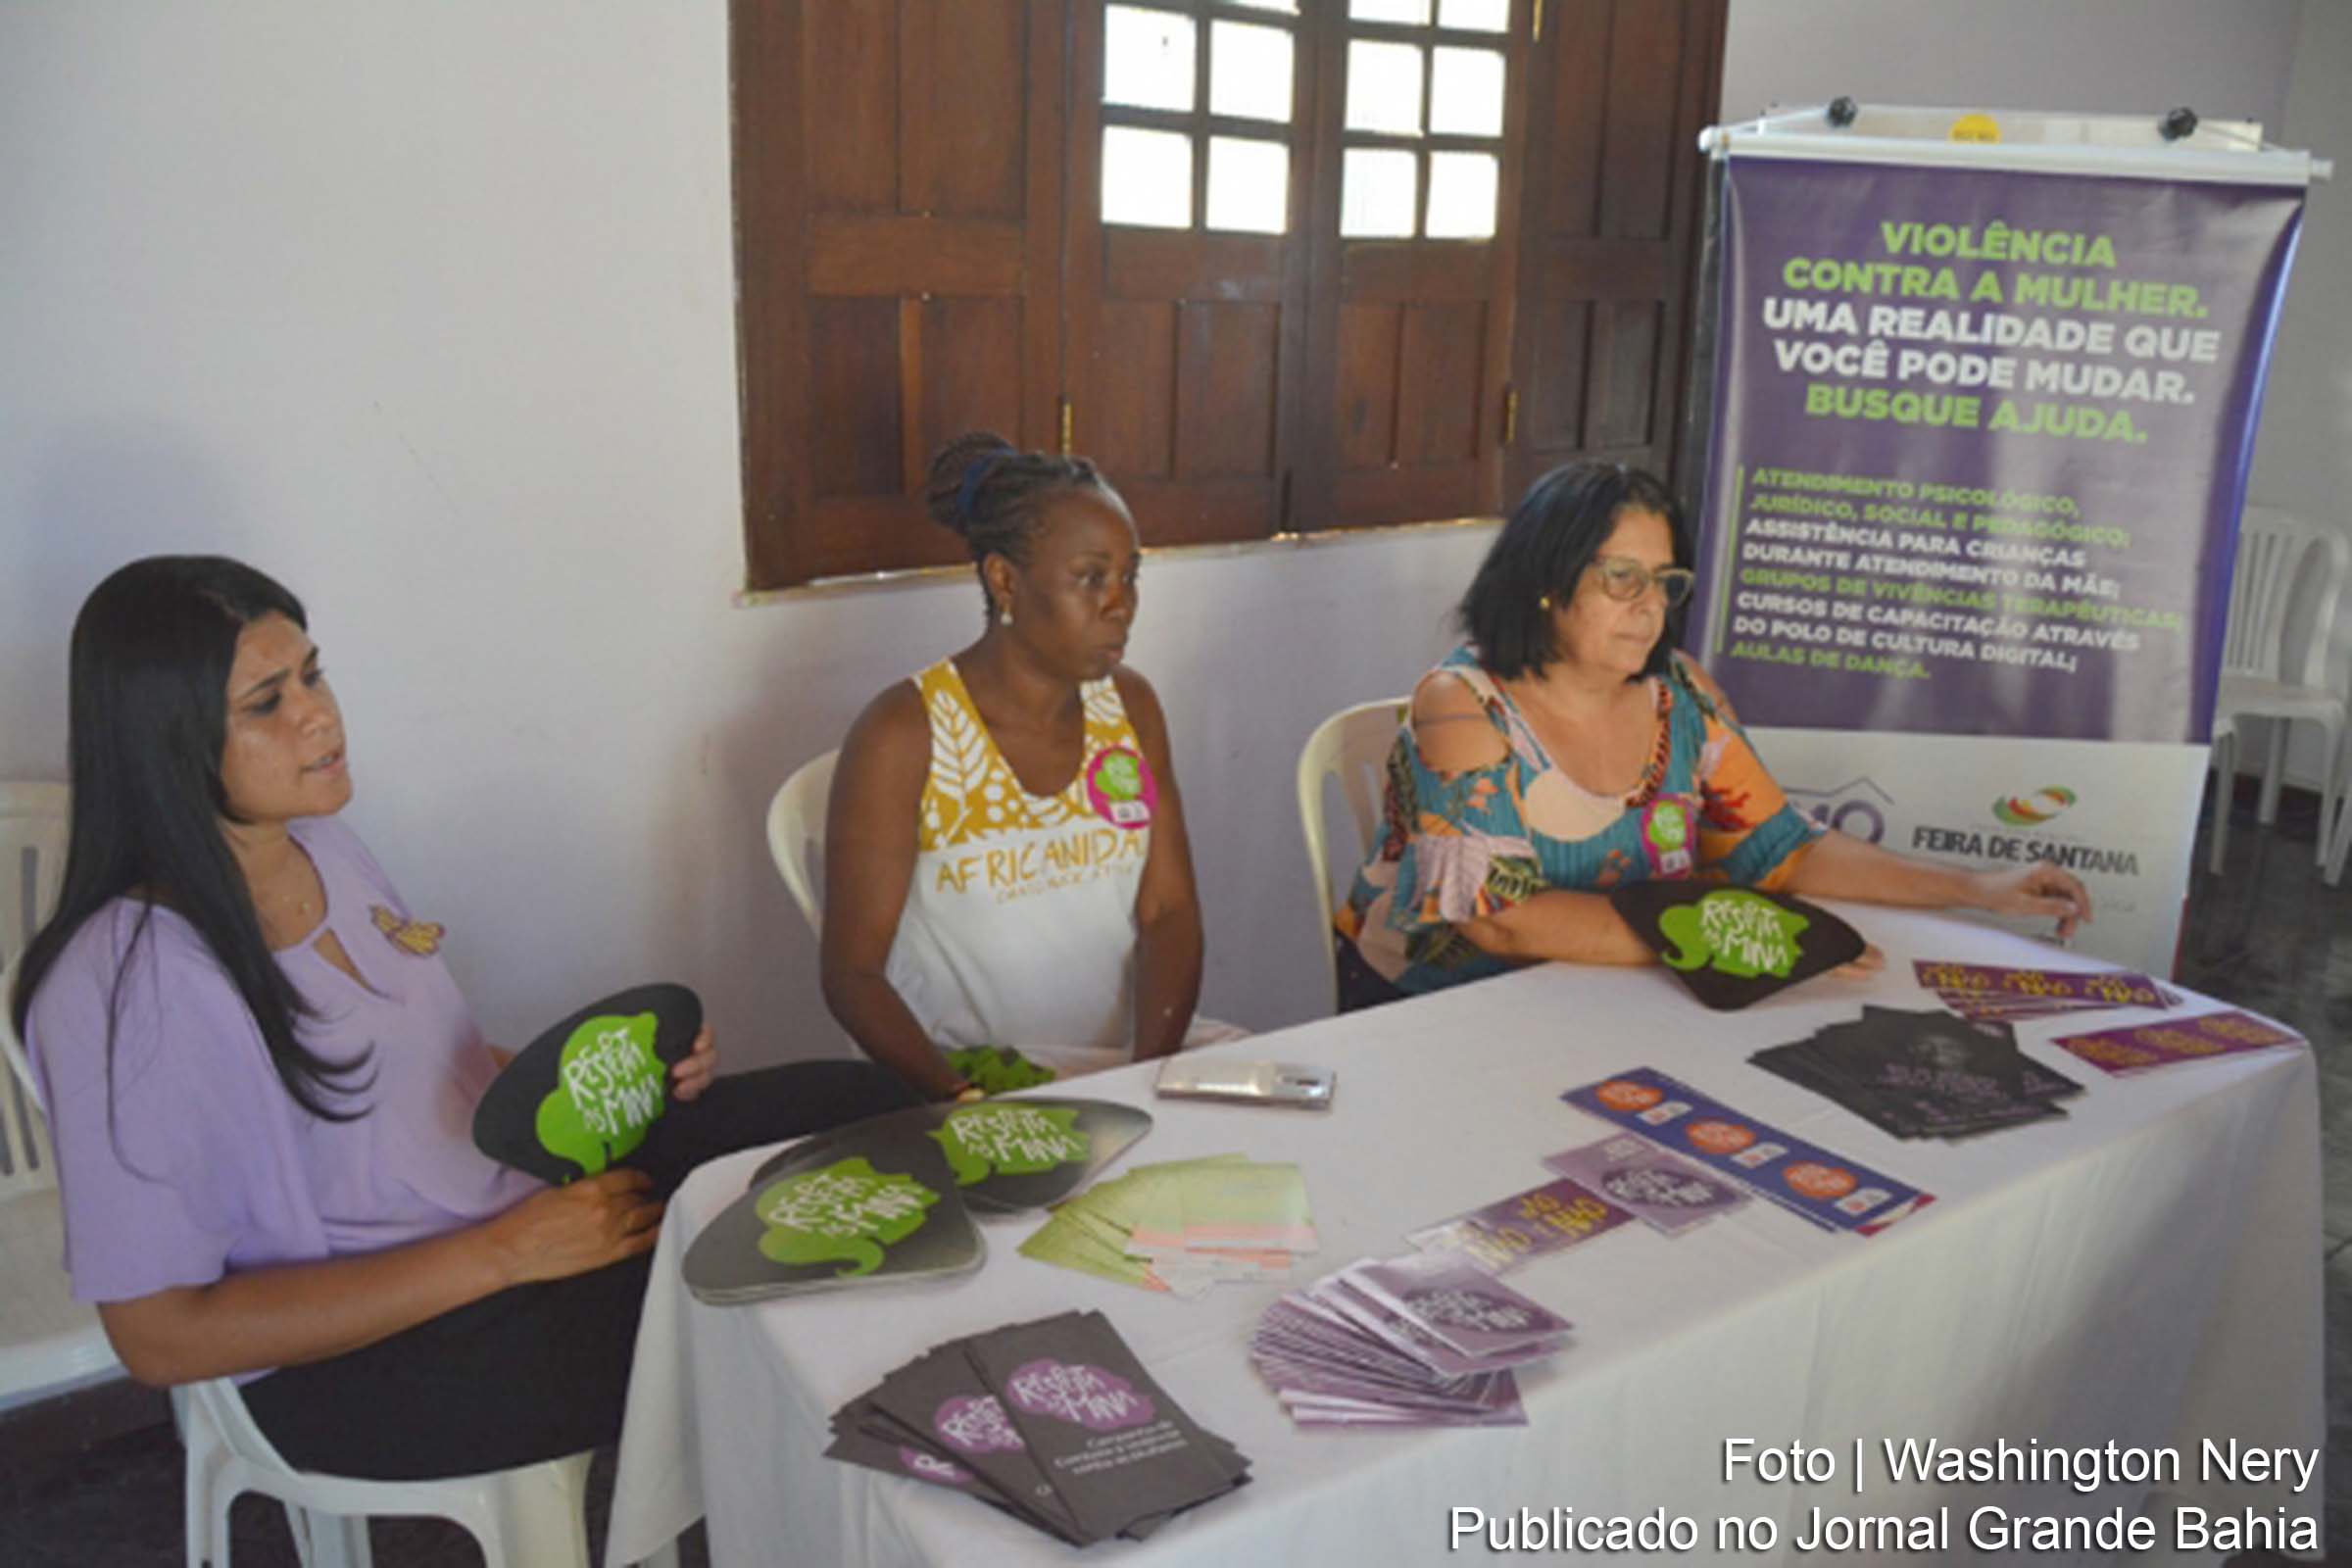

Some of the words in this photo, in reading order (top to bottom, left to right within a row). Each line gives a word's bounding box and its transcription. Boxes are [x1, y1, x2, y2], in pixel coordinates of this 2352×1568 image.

[1881, 220, 2117, 269] VIOLÊNCIA
[1783, 258, 1959, 300] CONTRA
[1970, 270, 2003, 302] A
[2013, 271, 2209, 318] MULHER.
[1763, 297, 1858, 334] UMA
[1868, 305, 2115, 353] REALIDADE
[2124, 325, 2222, 363] QUE
[1774, 339, 1890, 378] VOCÊ
[1897, 349, 2018, 389] PODE
[2025, 359, 2195, 404] MUDAR.
[1805, 383, 1982, 428] BUSQUE
[1987, 398, 2149, 443] AJUDA.
[1752, 467, 1914, 498] ATENDIMENTO
[1864, 504, 1946, 528] SOCIAL
[1952, 513, 1967, 530] E
[1741, 543, 1852, 569] DURANTE
[1854, 554, 2018, 587] ATENDIMENTO
[2022, 570, 2056, 592] DA
[1745, 518, 1893, 548] ASSISTÊNCIA
[1898, 532, 1960, 555] PARA
[1966, 540, 2086, 568] CRIANÇAS
[1740, 568, 1831, 592] GRUPOS
[1836, 575, 1866, 596] DE
[1873, 580, 1996, 610] VIVÊNCIAS
[1734, 616, 1766, 635] DO
[1770, 618, 1833, 643] POLO
[1836, 627, 1866, 646] DE
[1872, 631, 1975, 660] CULTURA
[1737, 591, 1828, 617] CURSOS
[1832, 602, 1864, 619] DE
[1867, 606, 2028, 639] CAPACITAÇÃO
[2032, 624, 2140, 651] ATRAVÉS
[1730, 641, 1805, 663] AULAS
[1810, 650, 1840, 668] DE
[1845, 655, 1932, 679] DANÇA.
[1913, 825, 1983, 858] FEIRA
[1987, 836, 2022, 859] DE
[2025, 840, 2139, 875] SANTANA
